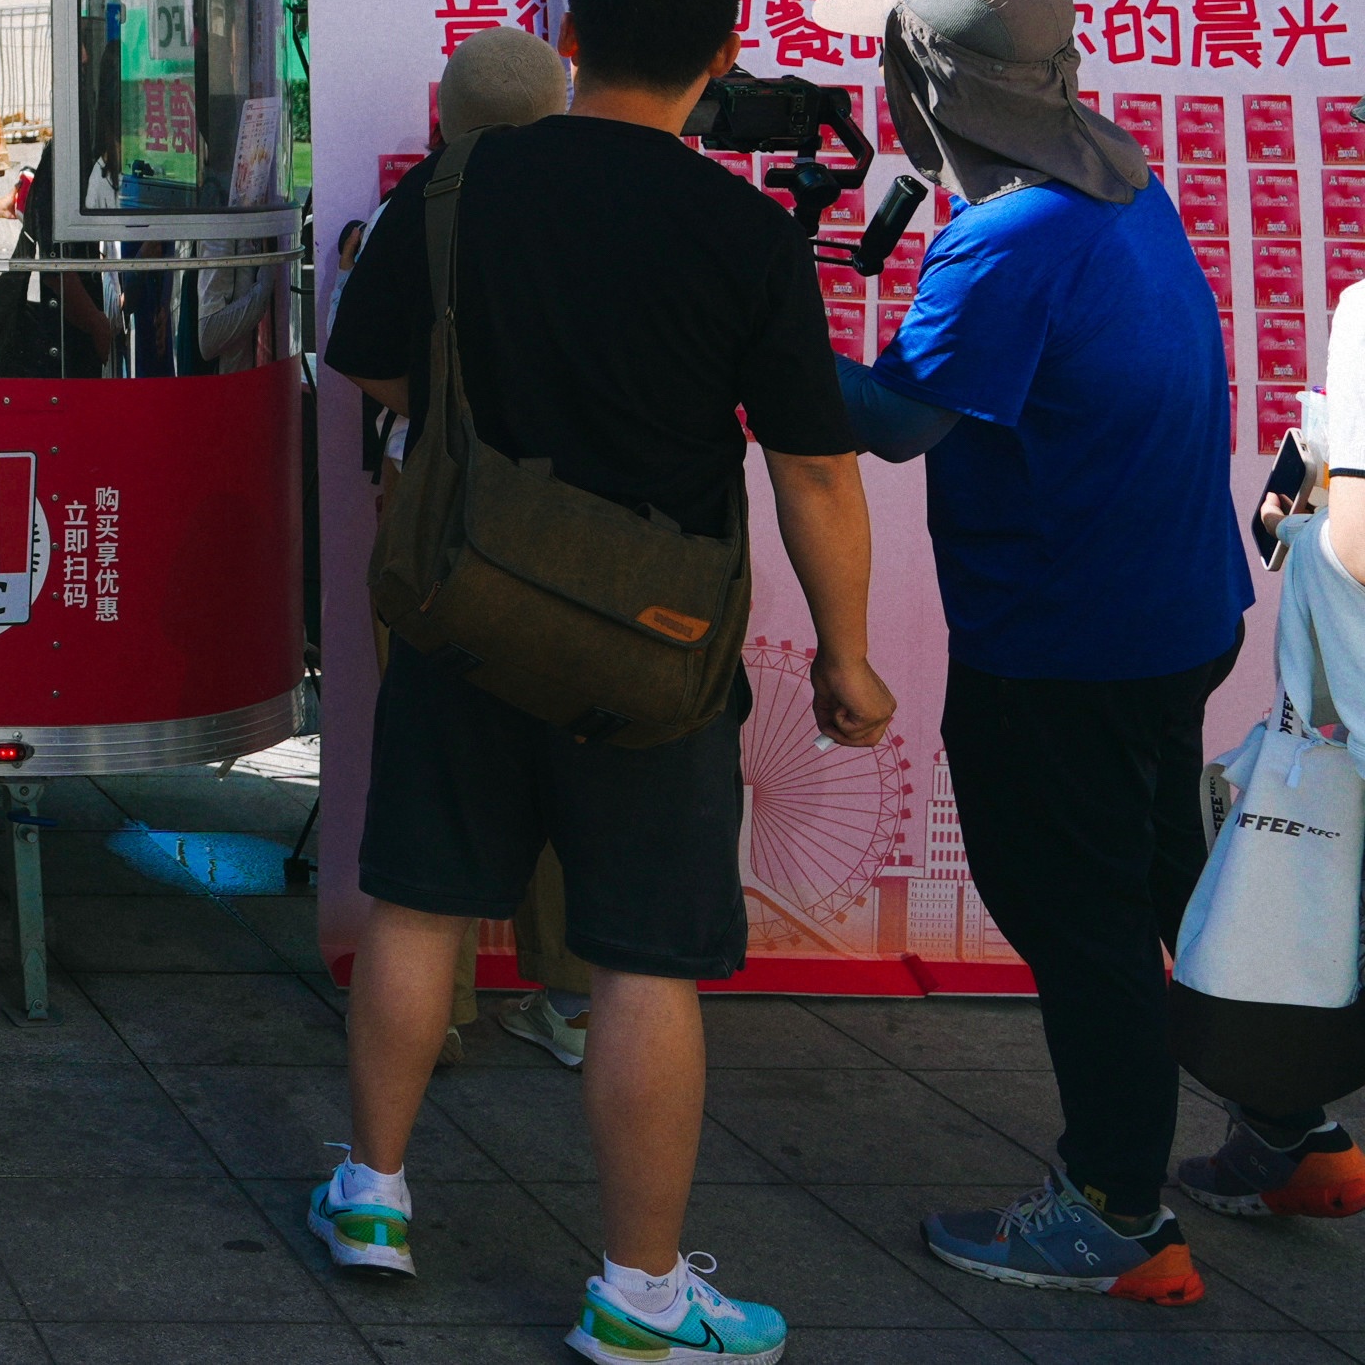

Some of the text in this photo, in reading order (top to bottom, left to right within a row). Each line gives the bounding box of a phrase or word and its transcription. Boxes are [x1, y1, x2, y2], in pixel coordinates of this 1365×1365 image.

[63, 500, 88, 609] 立即扫码
[95, 486, 119, 622] 购买享优惠
[1235, 812, 1305, 837] FFEE
